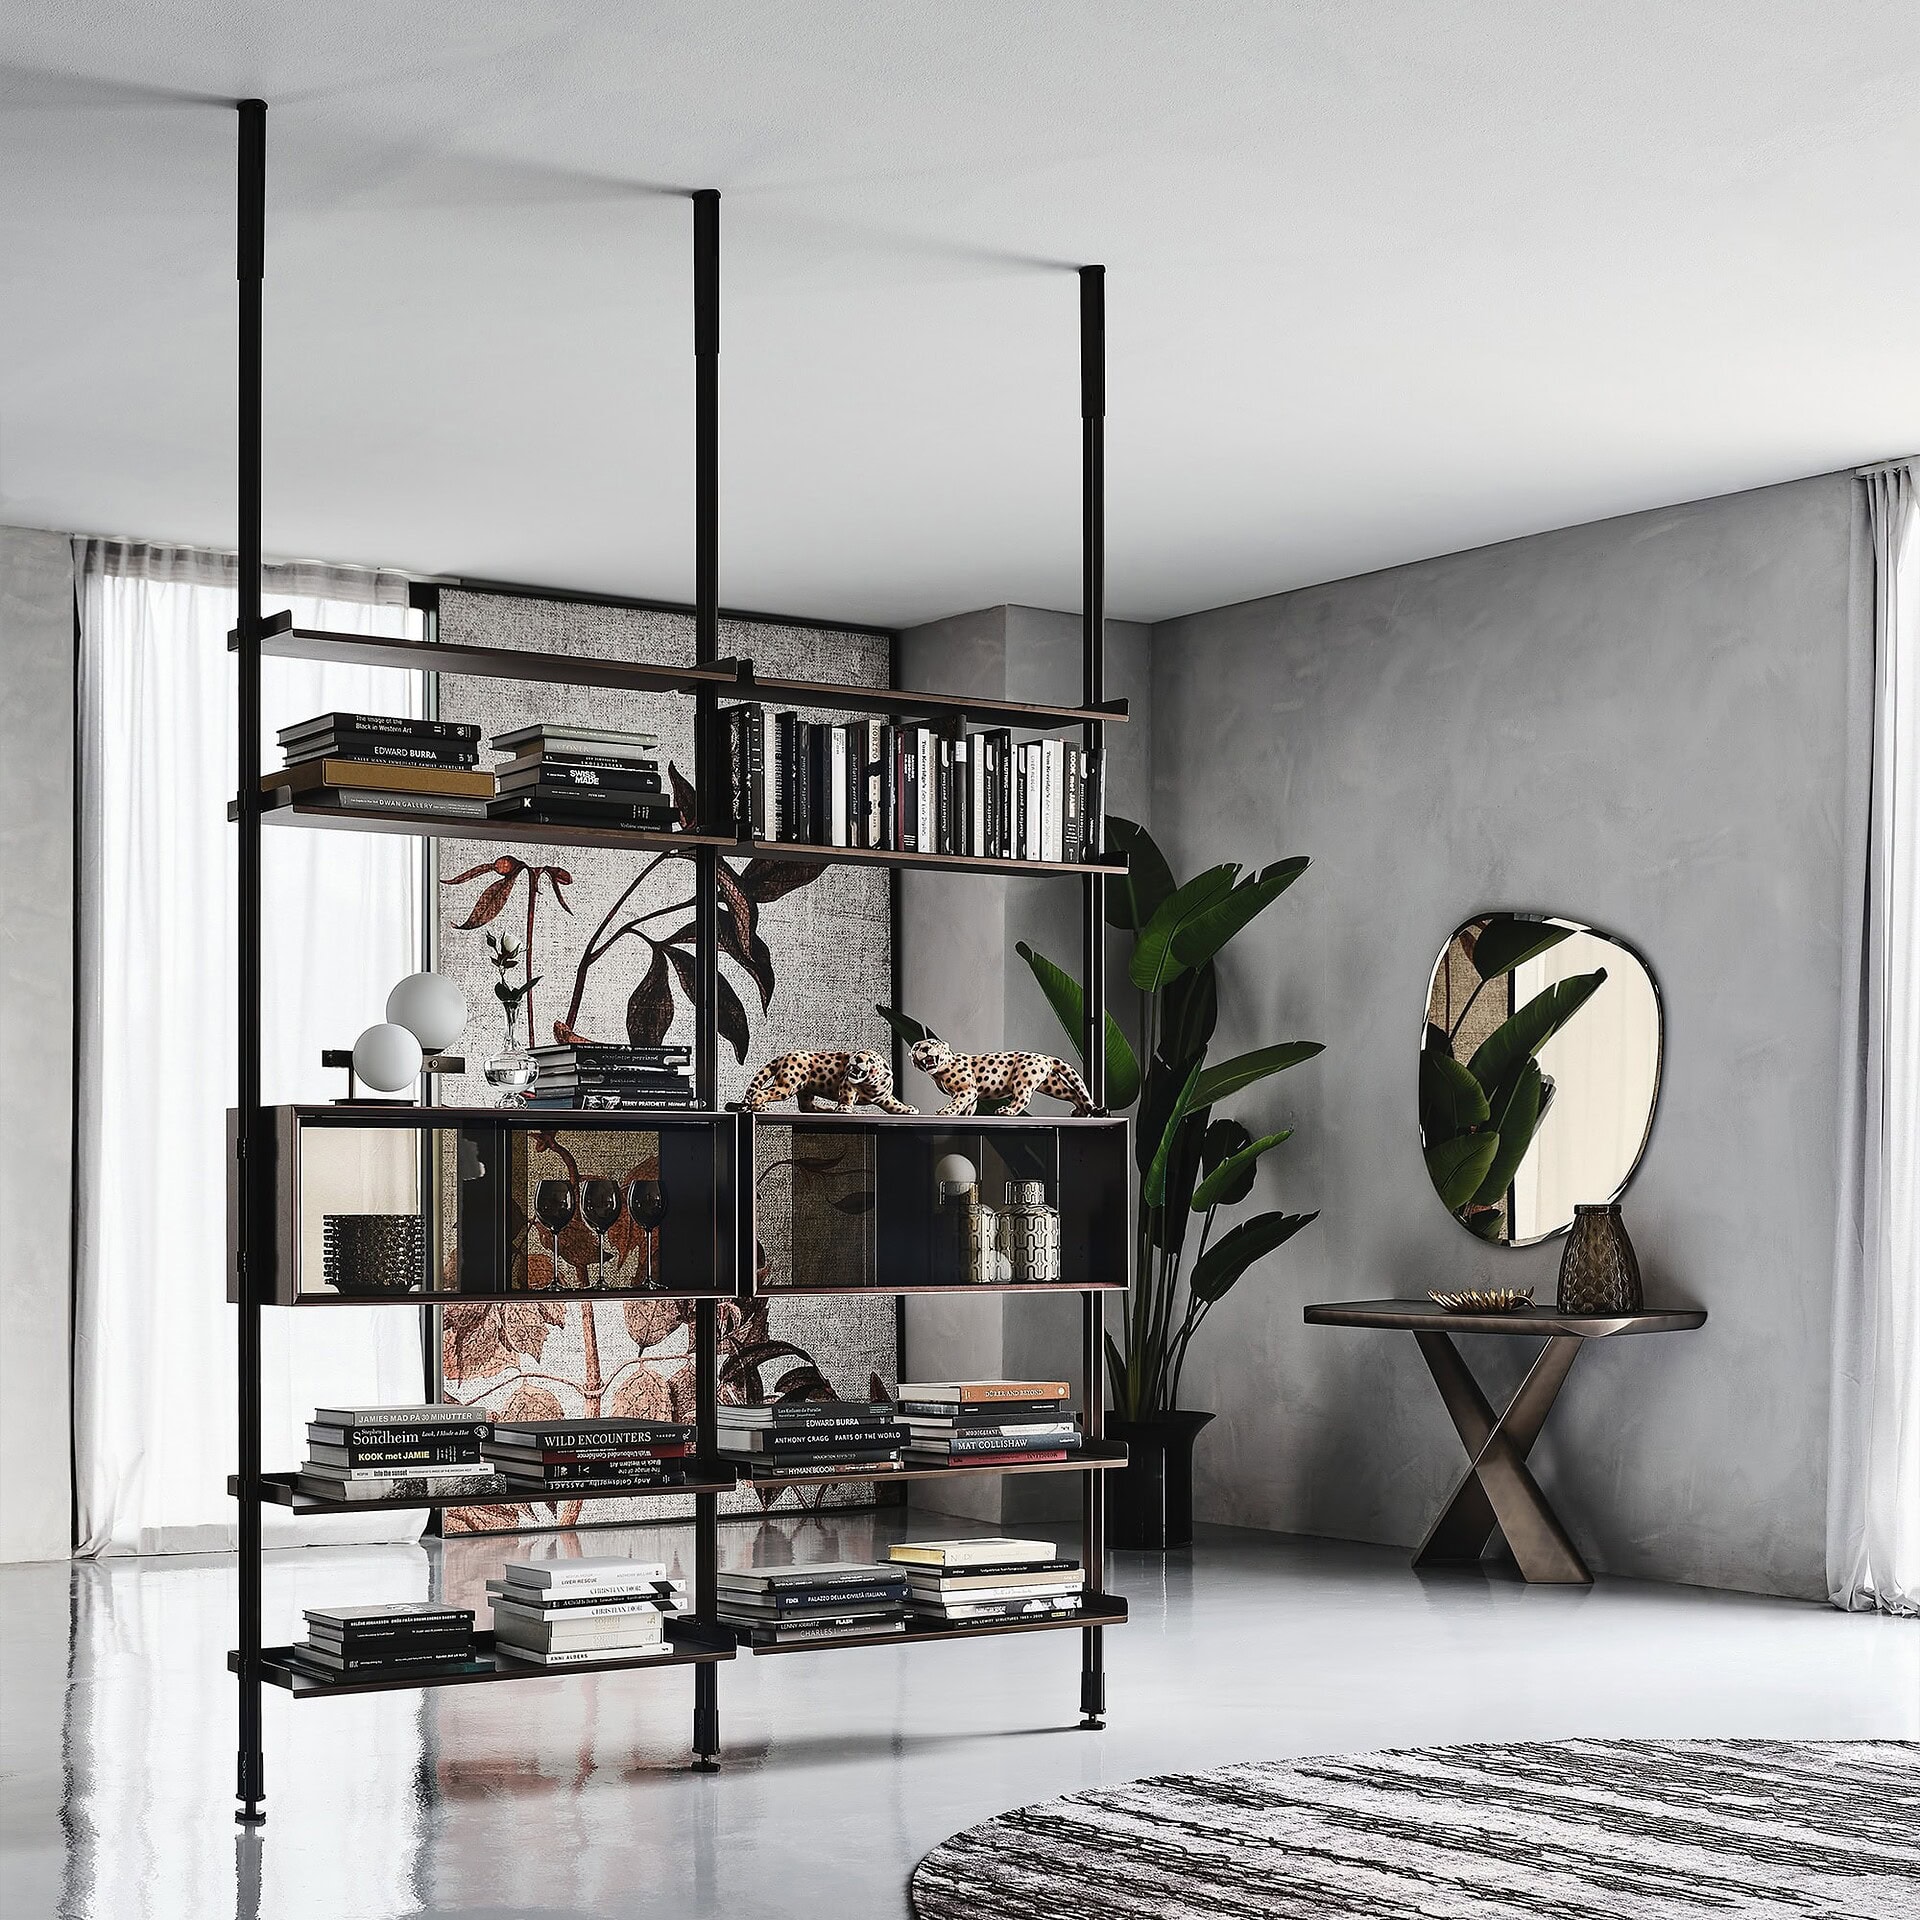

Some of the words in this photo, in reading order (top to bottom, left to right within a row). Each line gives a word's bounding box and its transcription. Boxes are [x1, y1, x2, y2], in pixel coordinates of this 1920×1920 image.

[379, 725, 402, 733] Western
[403, 726, 412, 734] Art
[374, 746, 408, 757] EDWARD
[409, 748, 437, 760] BURRA
[570, 769, 596, 778] SWISS
[575, 776, 599, 785] MADE
[402, 801, 433, 809] GALLERY
[359, 1415, 389, 1423] JAMIES
[390, 1414, 409, 1422] MAD
[410, 1412, 420, 1421] PÅ
[430, 1412, 473, 1421] MINUTTER
[806, 1418, 835, 1427] EDWARD
[836, 1418, 859, 1426] BURRA
[352, 1430, 420, 1446] Sondheim
[545, 1435, 576, 1447] WILD
[578, 1431, 652, 1446] ENCOUNTERS
[774, 1436, 806, 1444] ANTHONY
[807, 1435, 830, 1443] CRAGG
[854, 1433, 863, 1441] OF
[864, 1432, 876, 1440] THE
[877, 1431, 901, 1439] WORLD
[958, 1441, 976, 1450] MAT
[978, 1439, 1028, 1450] COLLISHAW
[359, 1453, 384, 1461] KOOK
[385, 1452, 402, 1460] met
[403, 1451, 430, 1460] JAMIE
[577, 1452, 607, 1460] Confidence
[788, 1466, 813, 1475] HYMAN
[812, 1465, 836, 1474] BLOOM
[550, 1482, 585, 1490] PASSAGE
[588, 1479, 632, 1487] Goldsworthy
[590, 1586, 625, 1595] CHRISTIAN
[591, 1607, 627, 1615] CHRISTIAN
[800, 1628, 833, 1638] CHARLES
